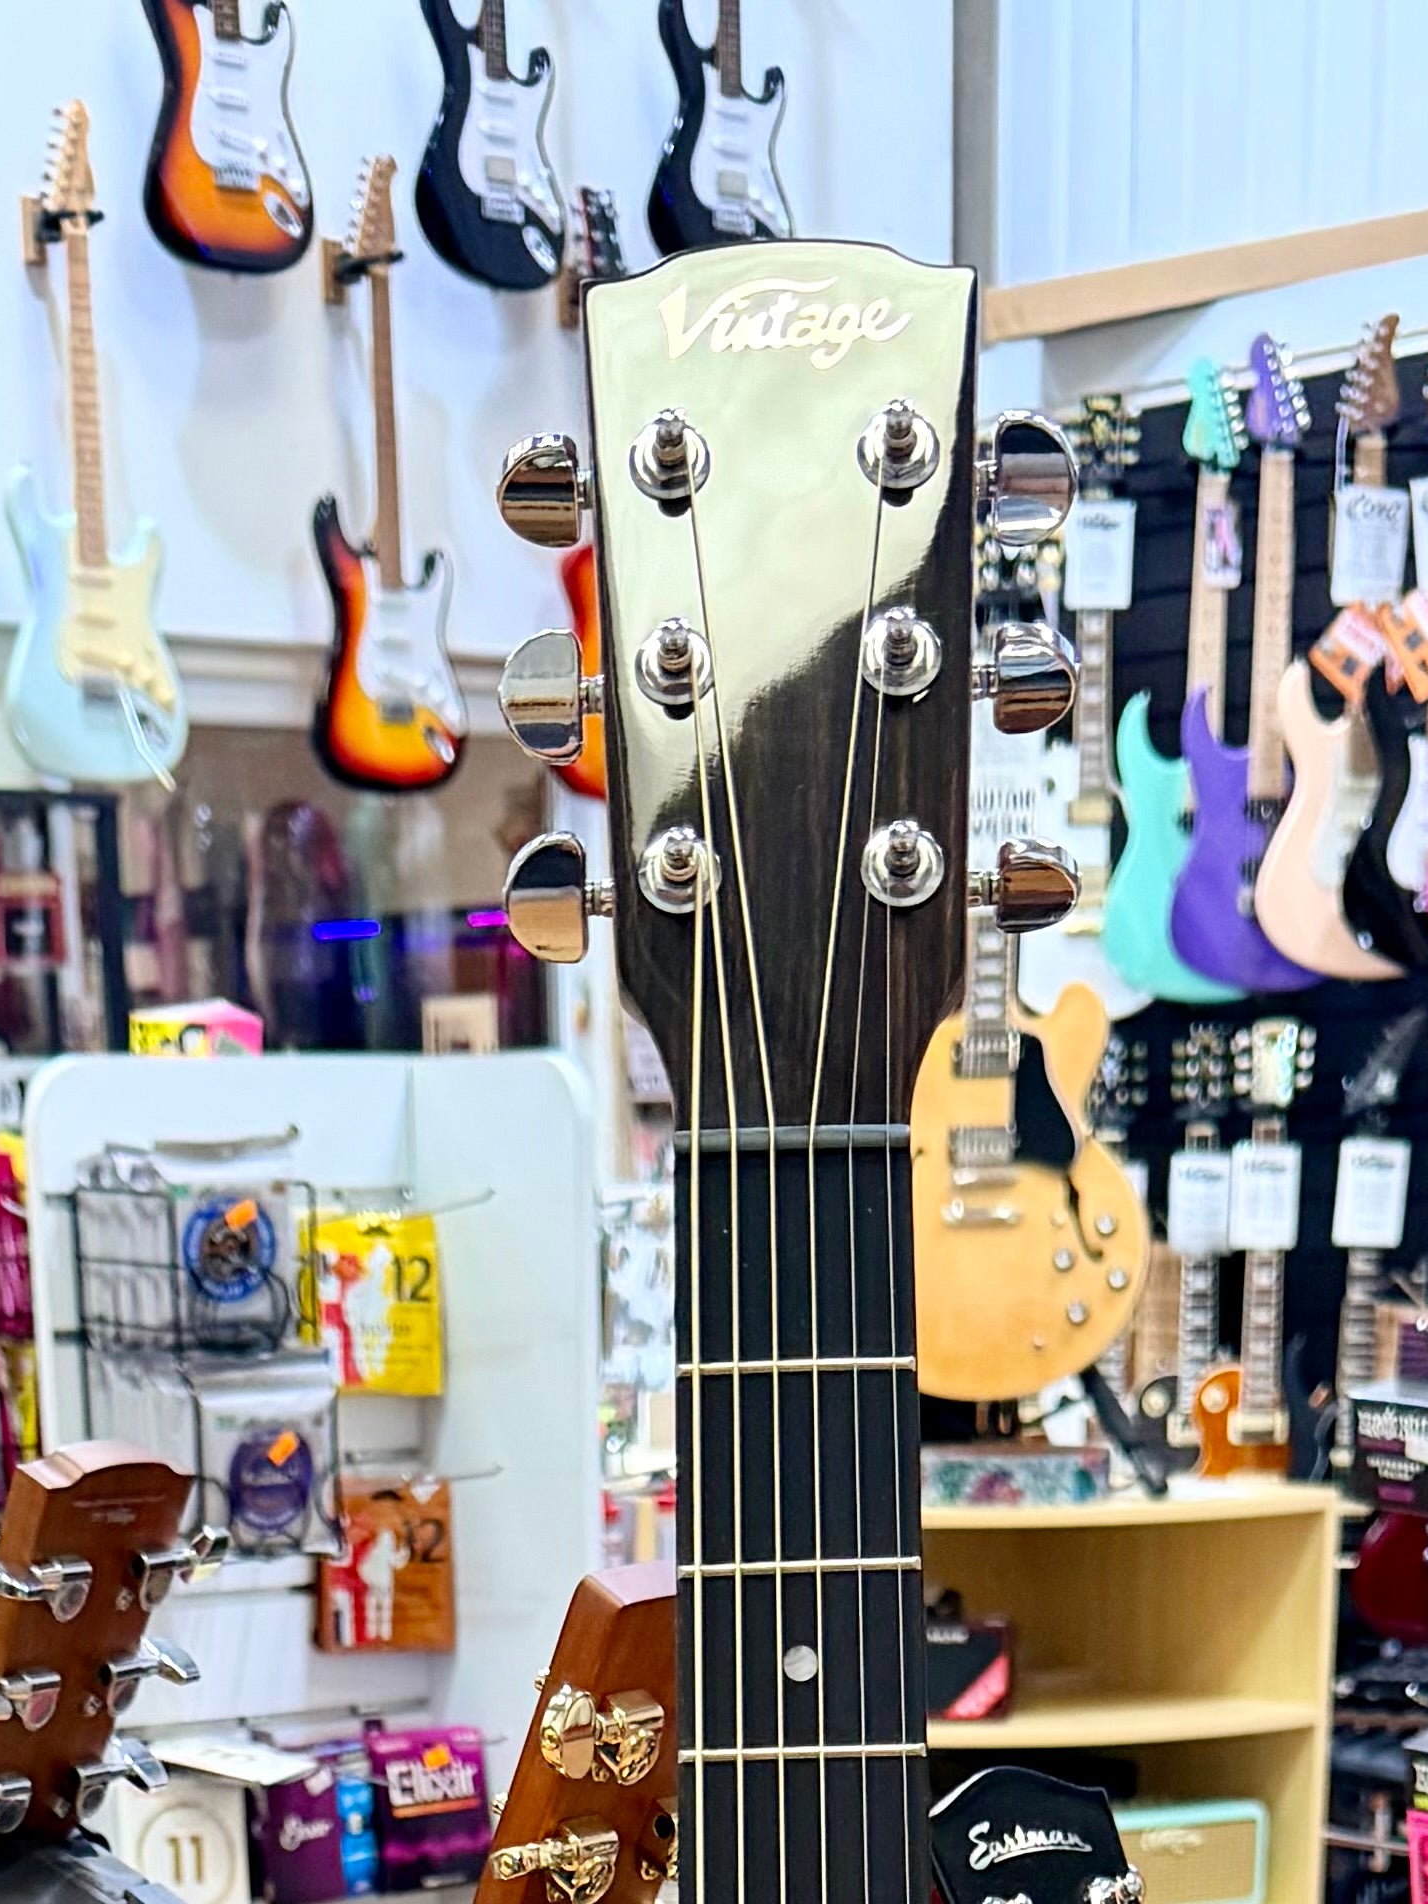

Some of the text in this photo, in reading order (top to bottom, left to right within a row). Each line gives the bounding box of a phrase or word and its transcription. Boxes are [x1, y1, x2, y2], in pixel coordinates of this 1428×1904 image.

[658, 275, 913, 370] Vintage
[391, 1254, 432, 1304] 12
[405, 1518, 446, 1563] 12
[385, 1757, 480, 1808] Elixir
[166, 1833, 206, 1885] 11
[968, 1820, 1093, 1871] Eastman
